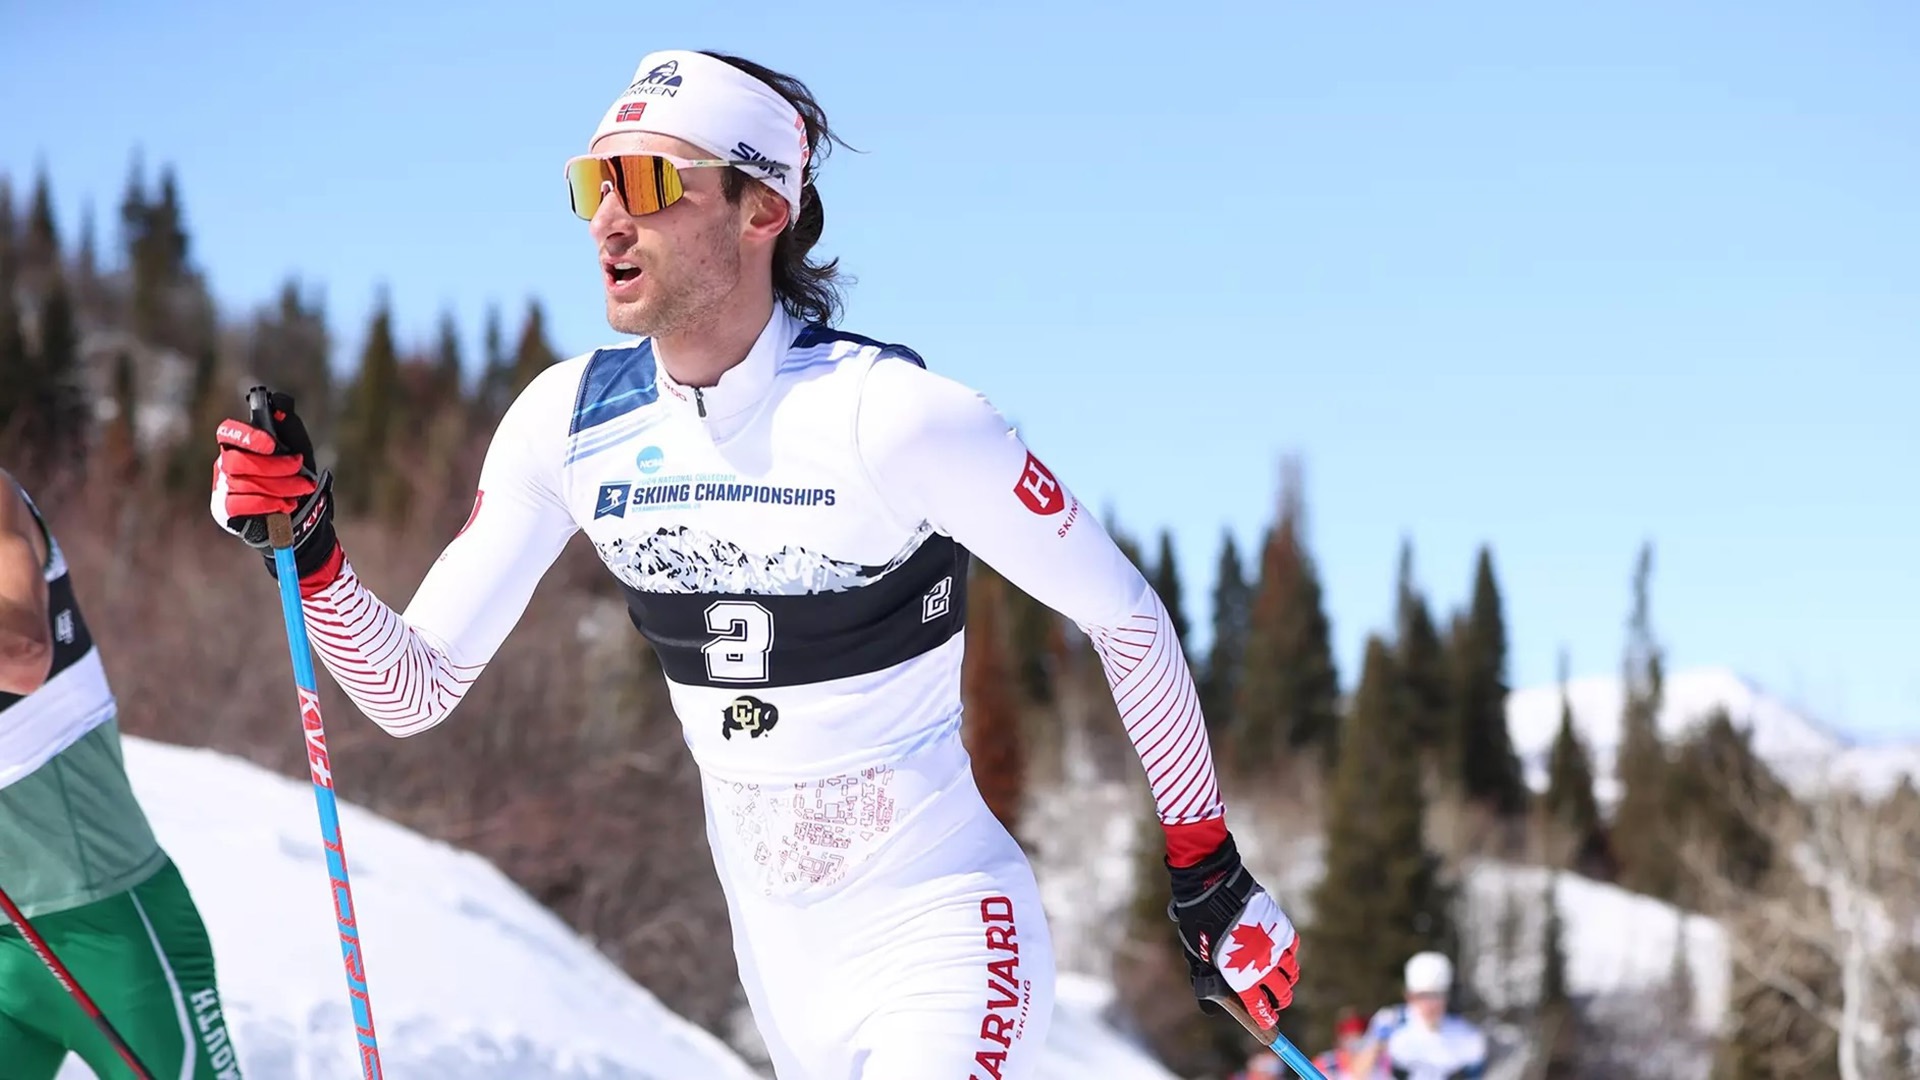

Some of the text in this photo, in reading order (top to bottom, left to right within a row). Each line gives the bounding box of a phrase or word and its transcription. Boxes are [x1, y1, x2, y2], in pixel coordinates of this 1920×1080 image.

[632, 483, 835, 506] SKIING CHAMPIONSHIPS
[658, 474, 693, 484] NATIONAL
[1022, 461, 1056, 509] H
[922, 576, 953, 624] 2
[701, 600, 775, 684] 2
[732, 700, 761, 730] CU
[1016, 980, 1032, 1040] SKIING
